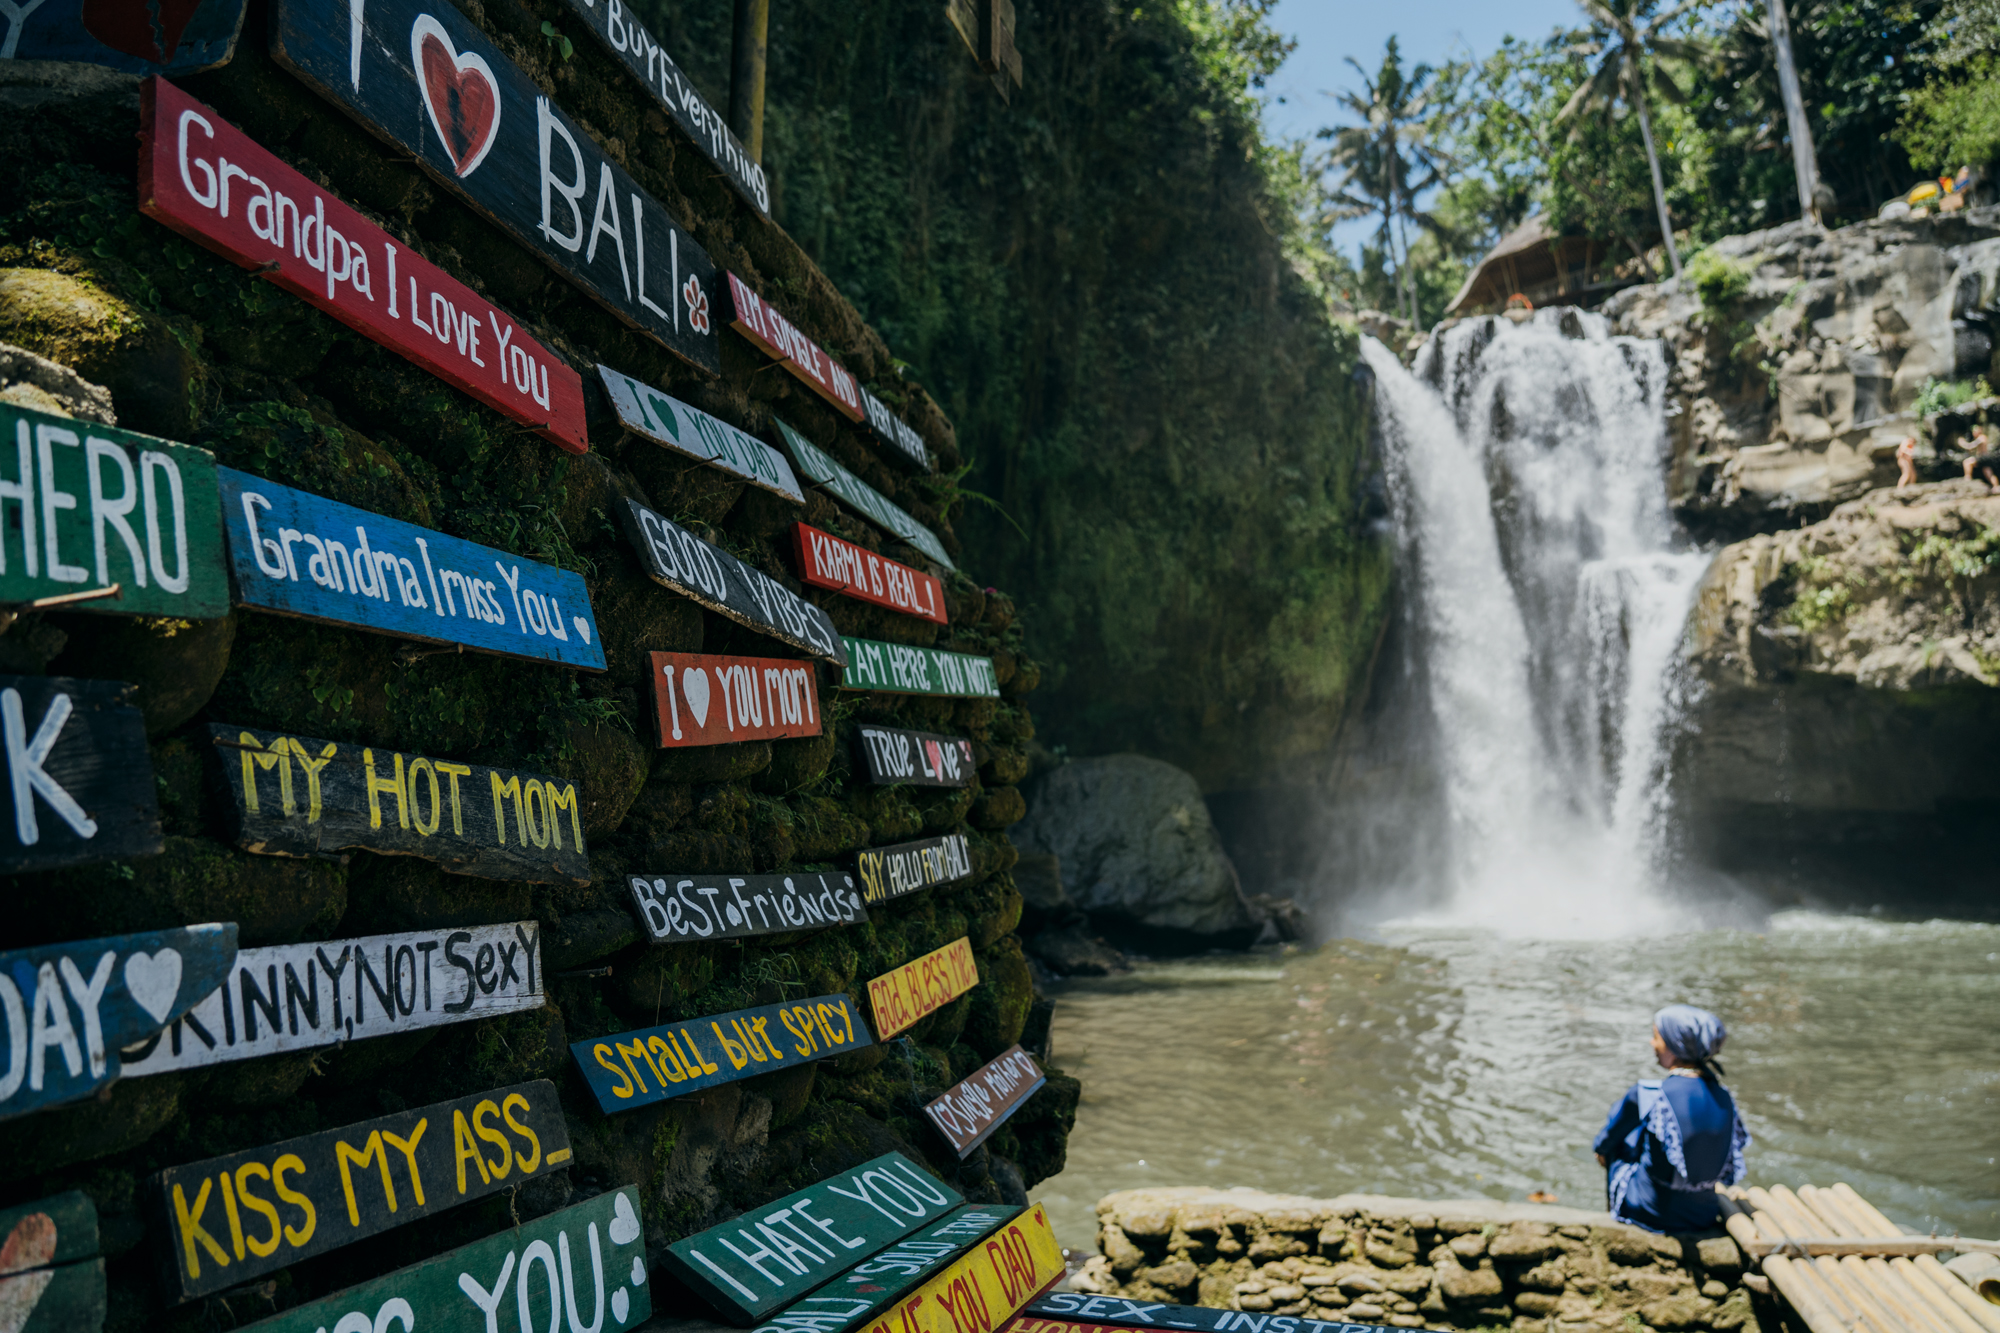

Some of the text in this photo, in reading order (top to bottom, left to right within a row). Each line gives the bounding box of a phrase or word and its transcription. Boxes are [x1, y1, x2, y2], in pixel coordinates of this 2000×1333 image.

[179, 110, 374, 301] Grandpa
[385, 242, 400, 319] I
[410, 276, 485, 368] LOVE
[537, 95, 679, 335] BALI
[624, 378, 779, 485] I YOU DAD
[241, 491, 428, 609] Grandma
[639, 508, 836, 657] GOOD VIBES
[810, 531, 868, 593] KARMA
[867, 554, 884, 598] IS
[663, 664, 683, 741] I
[716, 664, 764, 733] YOU
[855, 641, 888, 685] AM
[931, 651, 965, 694] YOU
[239, 731, 584, 855] MY HOT MOM
[858, 850, 886, 903] SAY
[921, 845, 949, 885] FROM
[941, 834, 971, 881] BALI
[779, 999, 855, 1057] SPICY
[173, 1153, 317, 1280] KISS
[335, 1117, 428, 1227] MY
[690, 1160, 948, 1303] I HATE YOU
[853, 1241, 959, 1275] SOLO
[930, 1212, 1003, 1237] TRIP
[458, 1221, 604, 1333] YOU
[936, 1268, 992, 1333] YOU
[985, 1225, 1037, 1309] DAD
[1042, 1293, 1166, 1322] SEX
